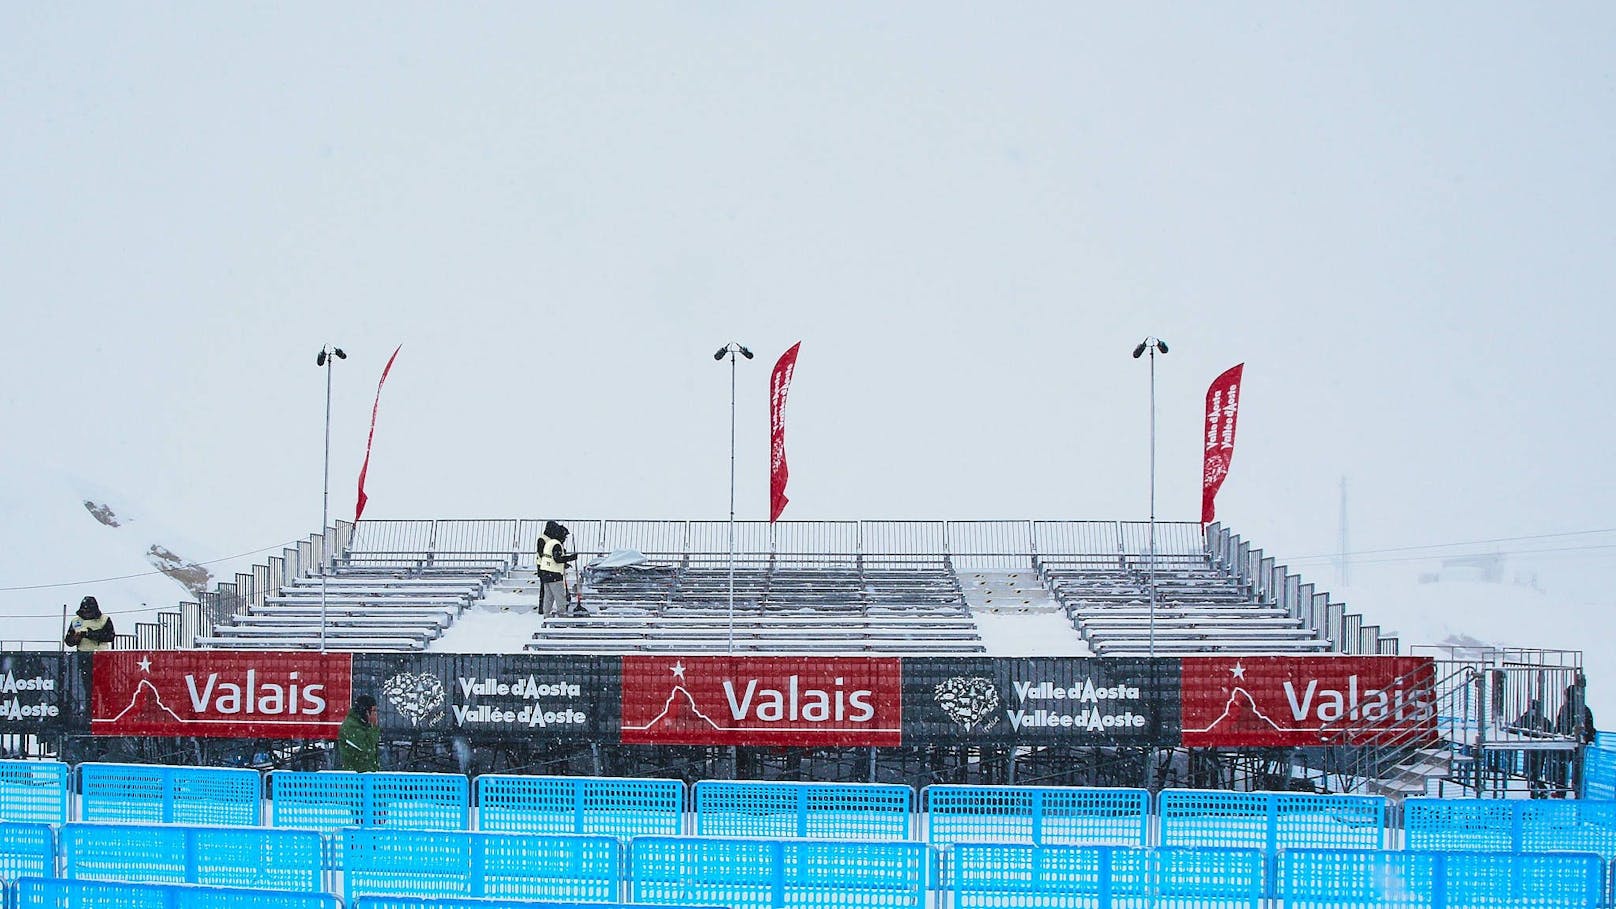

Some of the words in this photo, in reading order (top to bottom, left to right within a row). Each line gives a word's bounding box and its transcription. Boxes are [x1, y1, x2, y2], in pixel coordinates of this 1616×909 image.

[185, 668, 326, 715] Valais
[458, 677, 510, 700] Valle
[722, 674, 875, 722] Valais
[1012, 680, 1066, 704] Valle
[1283, 674, 1434, 721] Valais
[452, 704, 516, 728] Vallée
[1006, 709, 1073, 733] Vallée
